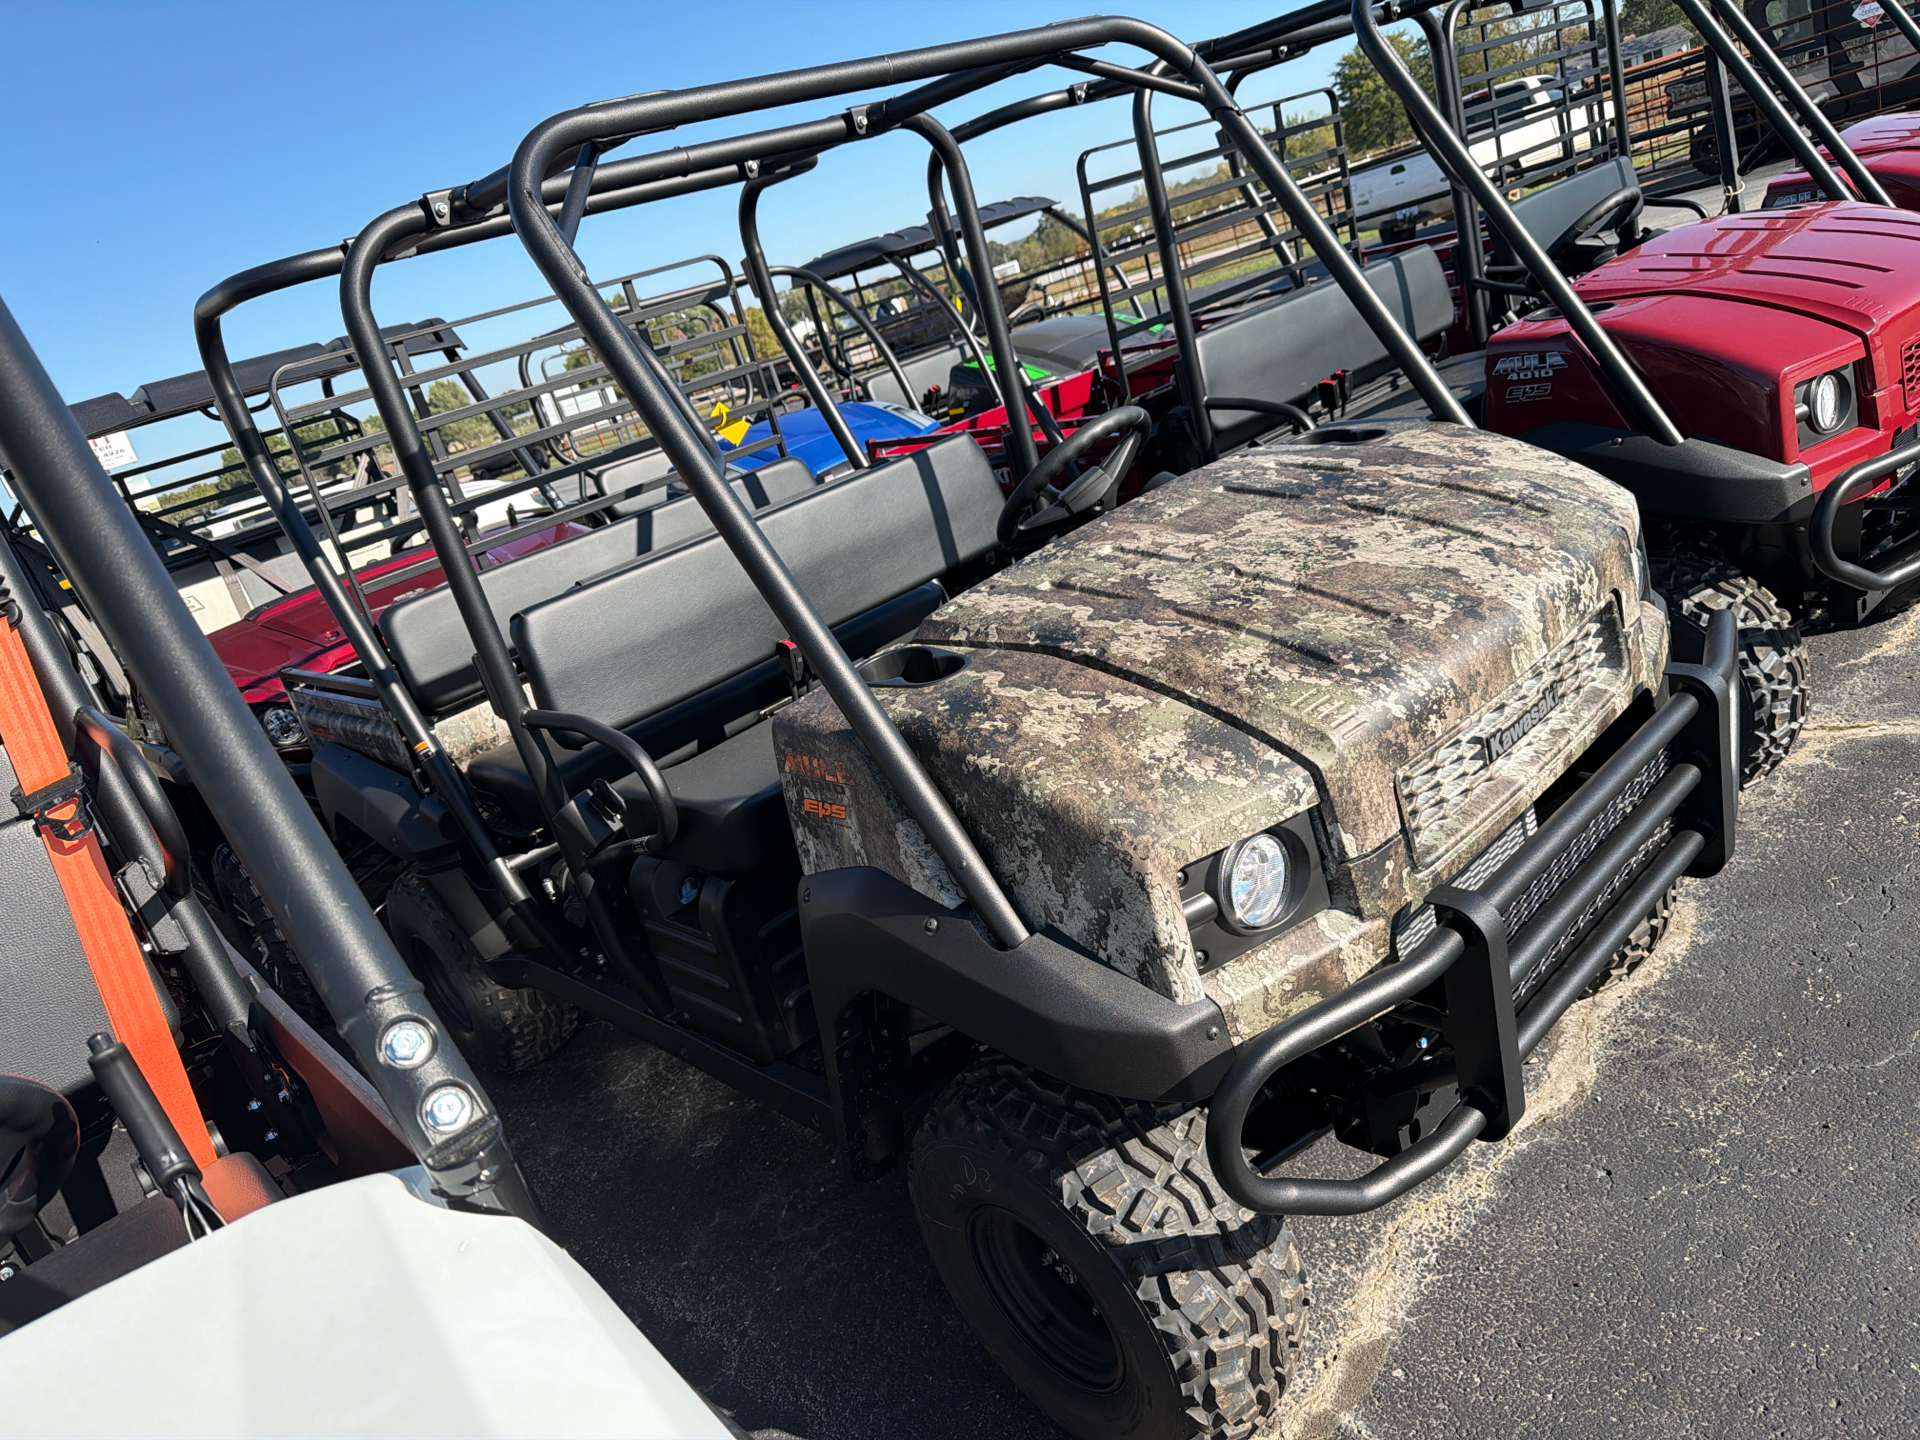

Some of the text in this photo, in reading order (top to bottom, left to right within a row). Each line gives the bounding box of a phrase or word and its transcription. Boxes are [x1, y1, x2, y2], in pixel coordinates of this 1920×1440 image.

[1491, 351, 1568, 375] MULE
[1507, 369, 1554, 380] 4010
[1489, 682, 1559, 761] Kawasaki
[784, 752, 857, 787] MULE
